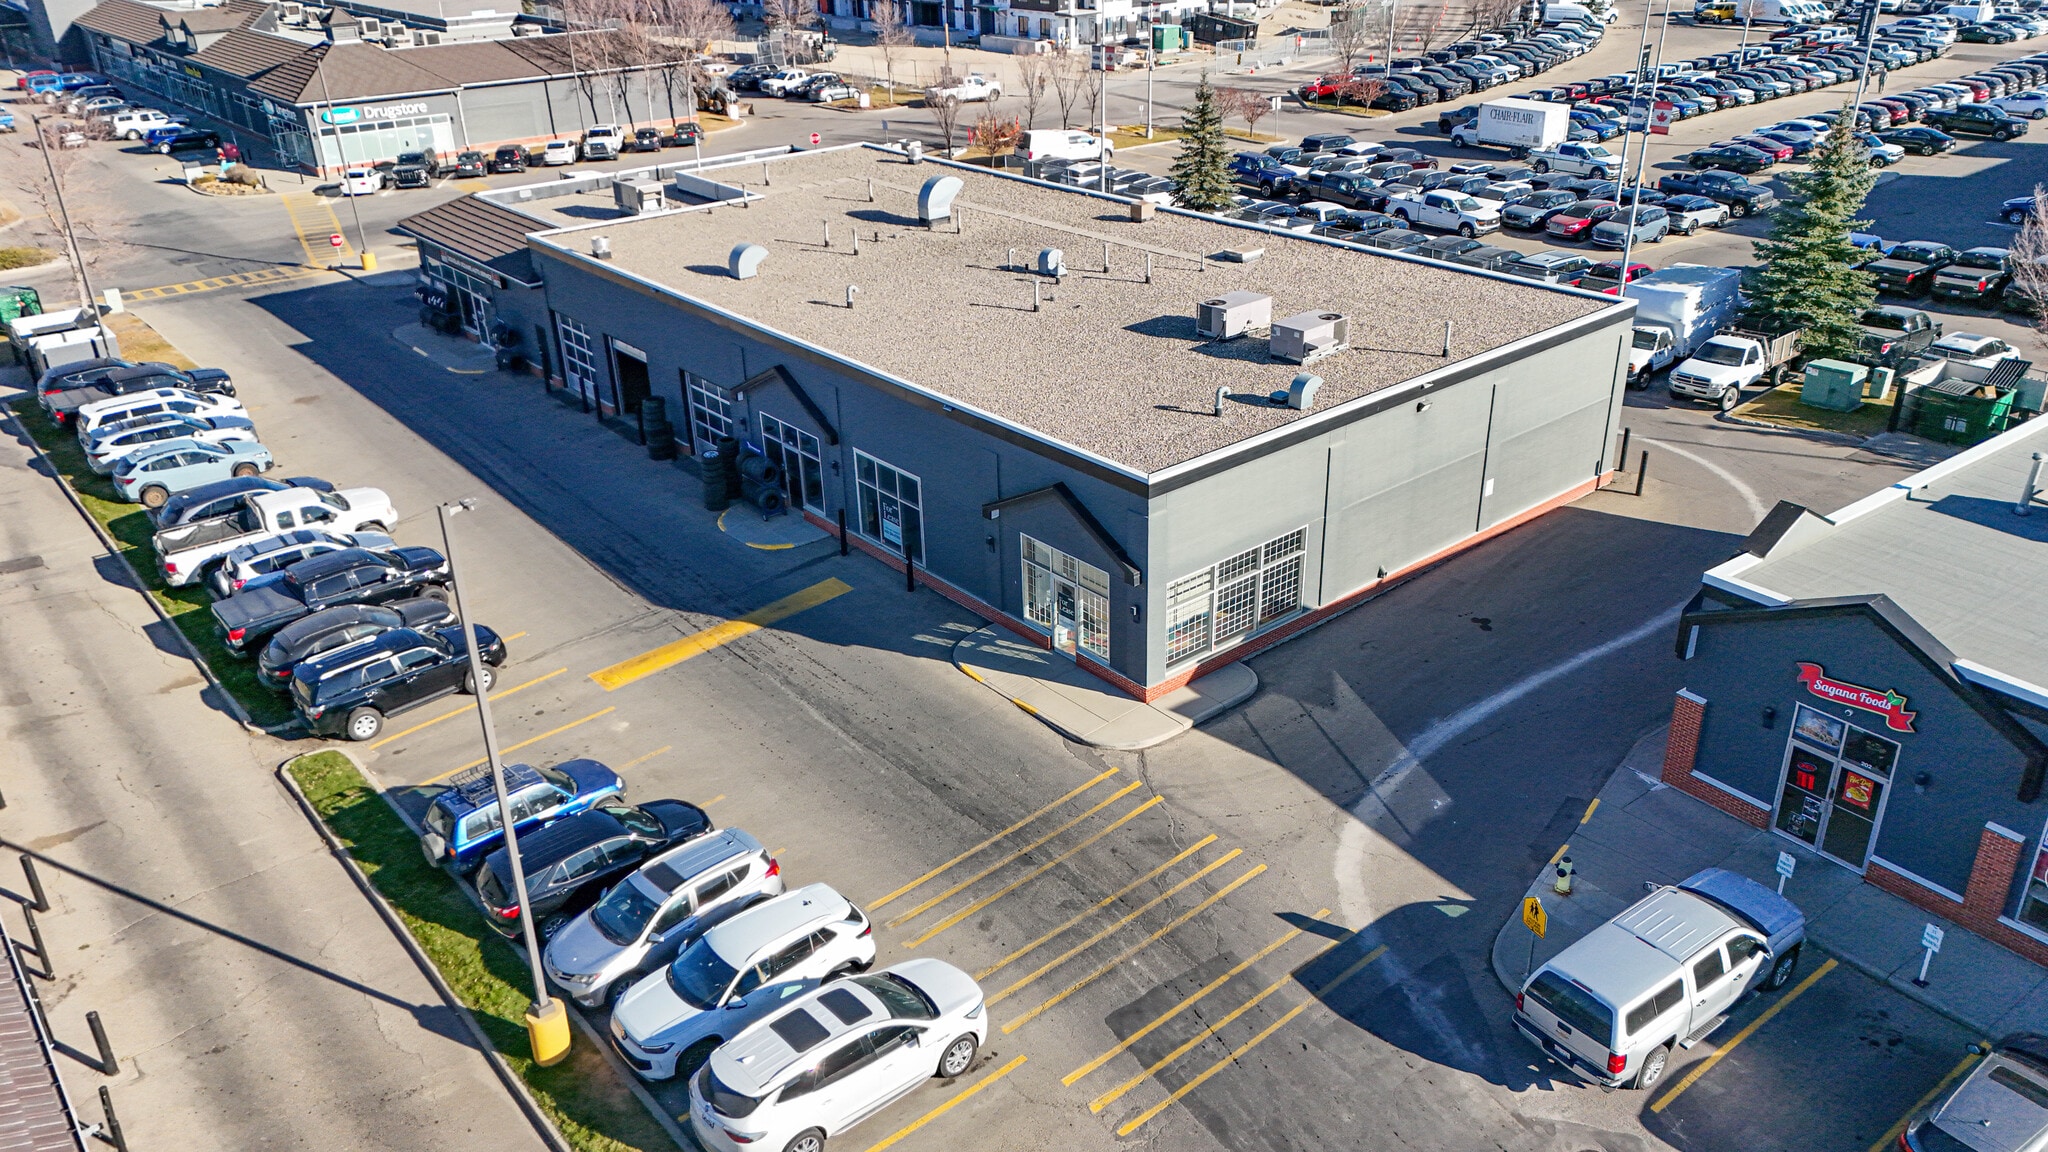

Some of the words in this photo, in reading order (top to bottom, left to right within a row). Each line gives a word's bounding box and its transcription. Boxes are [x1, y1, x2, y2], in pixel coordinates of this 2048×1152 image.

[363, 102, 428, 119] Drugstore
[1490, 108, 1534, 124] CHAIR-FLAIR
[1814, 680, 1857, 701] Sagana
[1859, 692, 1892, 710] Foods
[1860, 761, 1873, 770] 202
